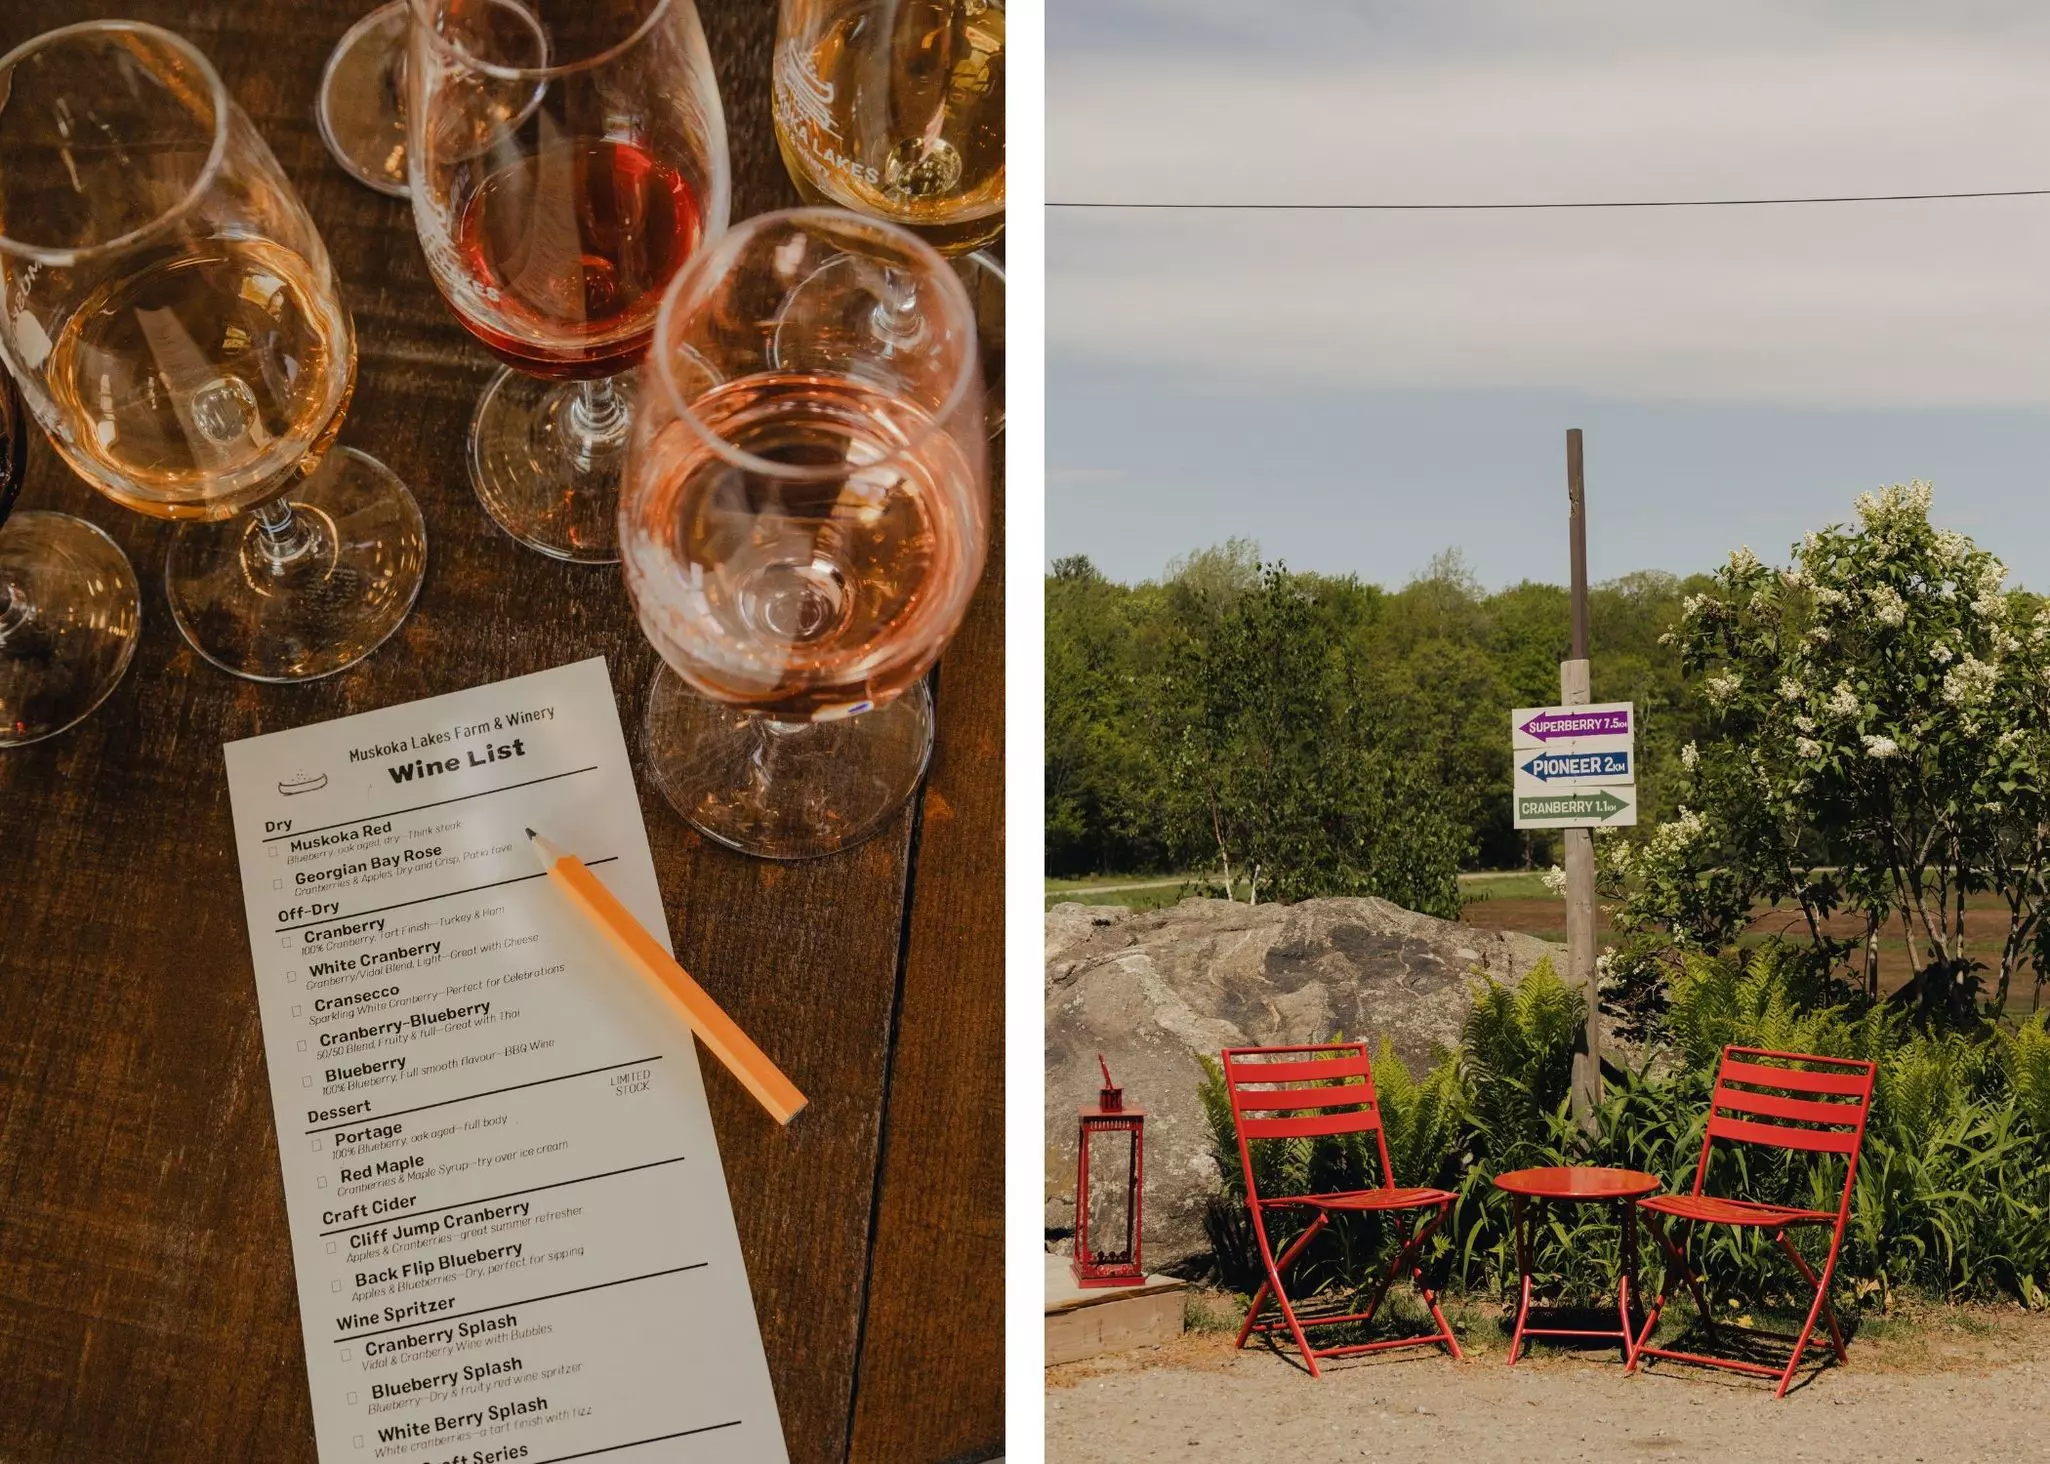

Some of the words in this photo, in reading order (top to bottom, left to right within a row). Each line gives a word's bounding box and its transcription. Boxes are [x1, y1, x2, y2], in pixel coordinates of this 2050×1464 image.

[812, 138, 880, 184] LAKES
[348, 740, 408, 762] Muskoka
[410, 731, 451, 749] Lakes
[454, 722, 490, 739] Farm
[494, 716, 503, 729] &
[505, 707, 554, 727] Winery
[1529, 718, 1602, 733] SUPERBERRY
[387, 757, 460, 784] Wine
[466, 738, 525, 767] List
[1533, 757, 1601, 775] PIONEER
[264, 819, 292, 833] Dry
[1521, 800, 1593, 815] CRANBERRY
[290, 830, 359, 853] Muskoka
[362, 821, 392, 837] Red
[435, 819, 461, 834] steak
[294, 878, 351, 897] Cranberries
[352, 875, 359, 885] &
[413, 859, 433, 871] and
[295, 862, 367, 885] Georgian
[370, 855, 400, 869] Bay
[403, 846, 442, 862] Rose
[277, 901, 339, 922] Off-Dry
[301, 943, 324, 956] 100%
[378, 927, 399, 940] Tart
[473, 909, 480, 919] &
[304, 918, 385, 943] Cranberry
[479, 940, 501, 953] with
[502, 934, 539, 948] Cheese
[308, 959, 356, 977] White
[359, 940, 440, 967] Cranberry
[308, 1009, 355, 1026] Sparkling
[356, 1001, 387, 1015] White
[486, 977, 500, 988] for
[502, 964, 565, 984] Celebrations
[314, 986, 400, 1012] Cransecco
[316, 1045, 344, 1060] 50/50
[377, 1032, 409, 1047] Fruity
[410, 1030, 417, 1040] &
[473, 1013, 496, 1026] with
[499, 1010, 520, 1020] Thai
[322, 1082, 346, 1096] 100%
[400, 1066, 418, 1080] Full
[420, 1058, 458, 1075] smooth
[528, 1039, 554, 1051] Wine
[325, 1056, 406, 1083] Blueberry
[610, 1069, 651, 1086] LIMITED
[616, 1079, 649, 1096] STOCK
[307, 1099, 371, 1123] Dessert
[332, 1146, 356, 1160] 100%
[410, 1130, 429, 1143] oak
[483, 1114, 507, 1127] body
[334, 1123, 402, 1146] Portage
[337, 1176, 397, 1197] Cranberries
[397, 1172, 405, 1183] &
[407, 1167, 436, 1182] Maple
[494, 1151, 518, 1163] over
[519, 1147, 534, 1157] ice
[535, 1140, 568, 1154] cream
[340, 1164, 372, 1183] Red
[375, 1155, 424, 1175] Maple
[322, 1204, 368, 1225] Craft
[371, 1195, 416, 1214] Cider
[349, 1228, 388, 1249] Cliff
[392, 1221, 440, 1240] Jump
[443, 1202, 529, 1229] Cranberry
[345, 1248, 380, 1263] Apples
[382, 1244, 389, 1256] &
[490, 1217, 532, 1234] summer
[535, 1206, 582, 1224] refresher
[351, 1287, 387, 1303] Apples
[388, 1283, 395, 1294] &
[487, 1256, 526, 1276] perfect
[529, 1253, 545, 1264] for
[547, 1246, 584, 1262] sipping
[355, 1267, 398, 1287] Back
[401, 1260, 435, 1278] Flip
[438, 1243, 522, 1270] Blueberry
[336, 1313, 379, 1331] Wine
[383, 1297, 455, 1323] Spritzer
[361, 1355, 388, 1371] Vidal
[390, 1354, 398, 1366] &
[399, 1345, 454, 1364] Cranberry
[455, 1339, 482, 1351] Wine
[484, 1332, 508, 1346] with
[510, 1324, 552, 1341] Bubbles
[365, 1328, 453, 1356] Cranberry
[458, 1313, 517, 1338] Splash
[371, 1371, 458, 1399] Blueberry
[462, 1357, 522, 1381] Splash
[450, 1386, 458, 1397] &
[460, 1381, 492, 1396] fruity
[493, 1375, 511, 1388] red
[512, 1371, 538, 1384] wine
[540, 1363, 583, 1379] spritzer
[373, 1443, 408, 1458] White
[489, 1421, 511, 1435] tart
[513, 1414, 543, 1430] finish
[544, 1409, 569, 1423] with
[377, 1422, 430, 1442] White
[434, 1411, 483, 1431] Berry
[488, 1396, 548, 1421] Splash
[472, 1444, 529, 1464] Series
